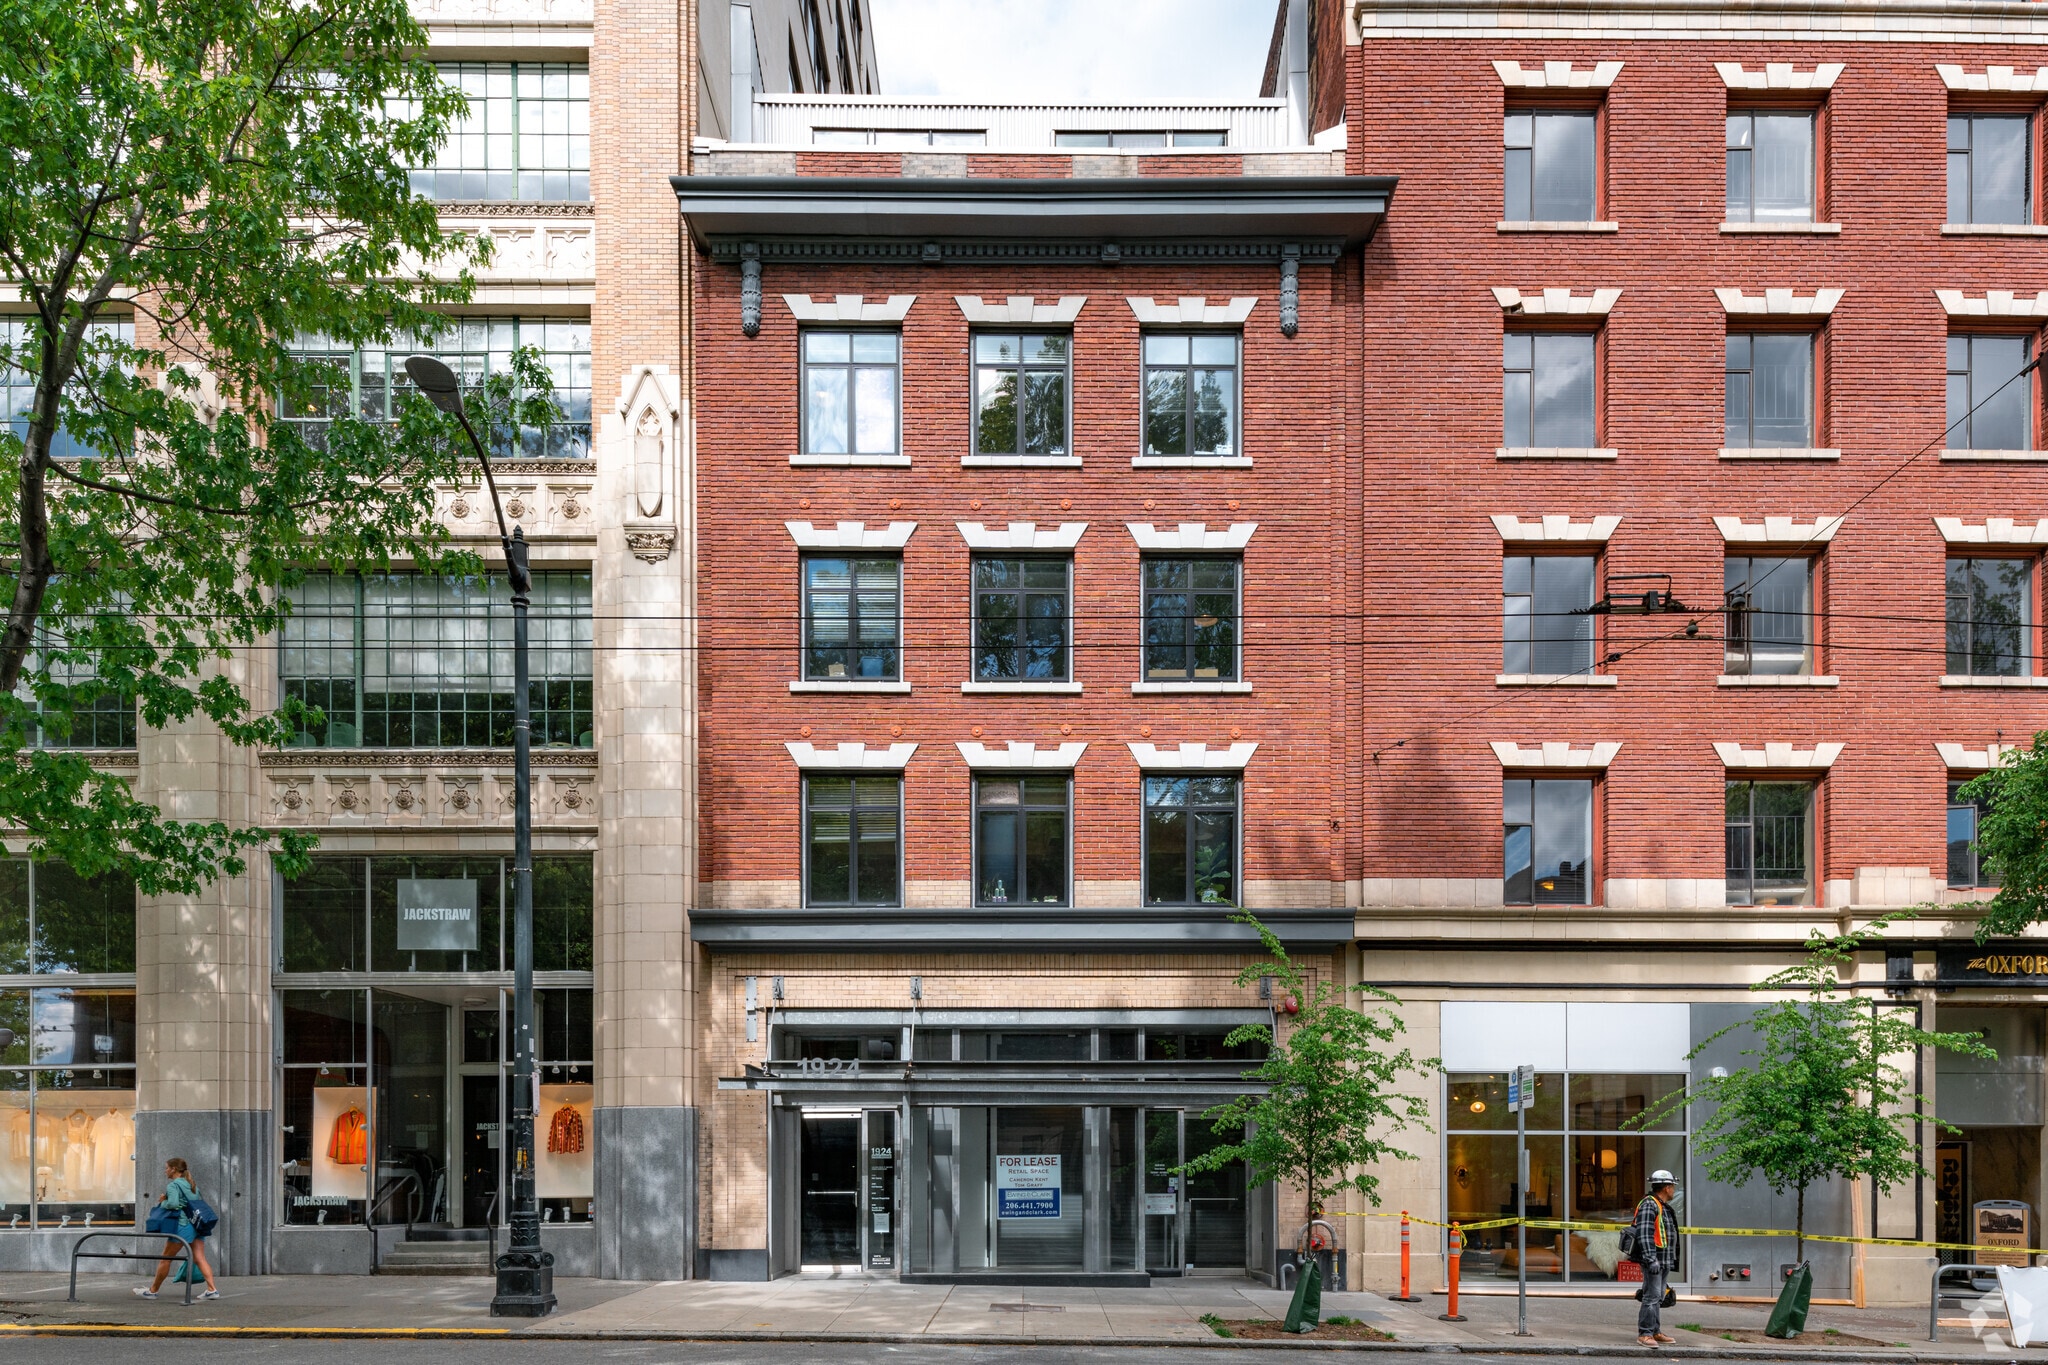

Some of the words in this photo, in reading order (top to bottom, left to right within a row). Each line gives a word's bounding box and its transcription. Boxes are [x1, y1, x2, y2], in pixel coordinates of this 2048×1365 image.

[403, 908, 471, 921] JACKSTRAW
[1965, 958, 1986, 970] The
[797, 1057, 860, 1079] 1924
[871, 1147, 892, 1155] 1924
[999, 1157, 1022, 1167] FOR
[1023, 1156, 1058, 1167] LEASE
[293, 1195, 349, 1207] JACKSTRAW
[1987, 1238, 2020, 1246] OXFORD
